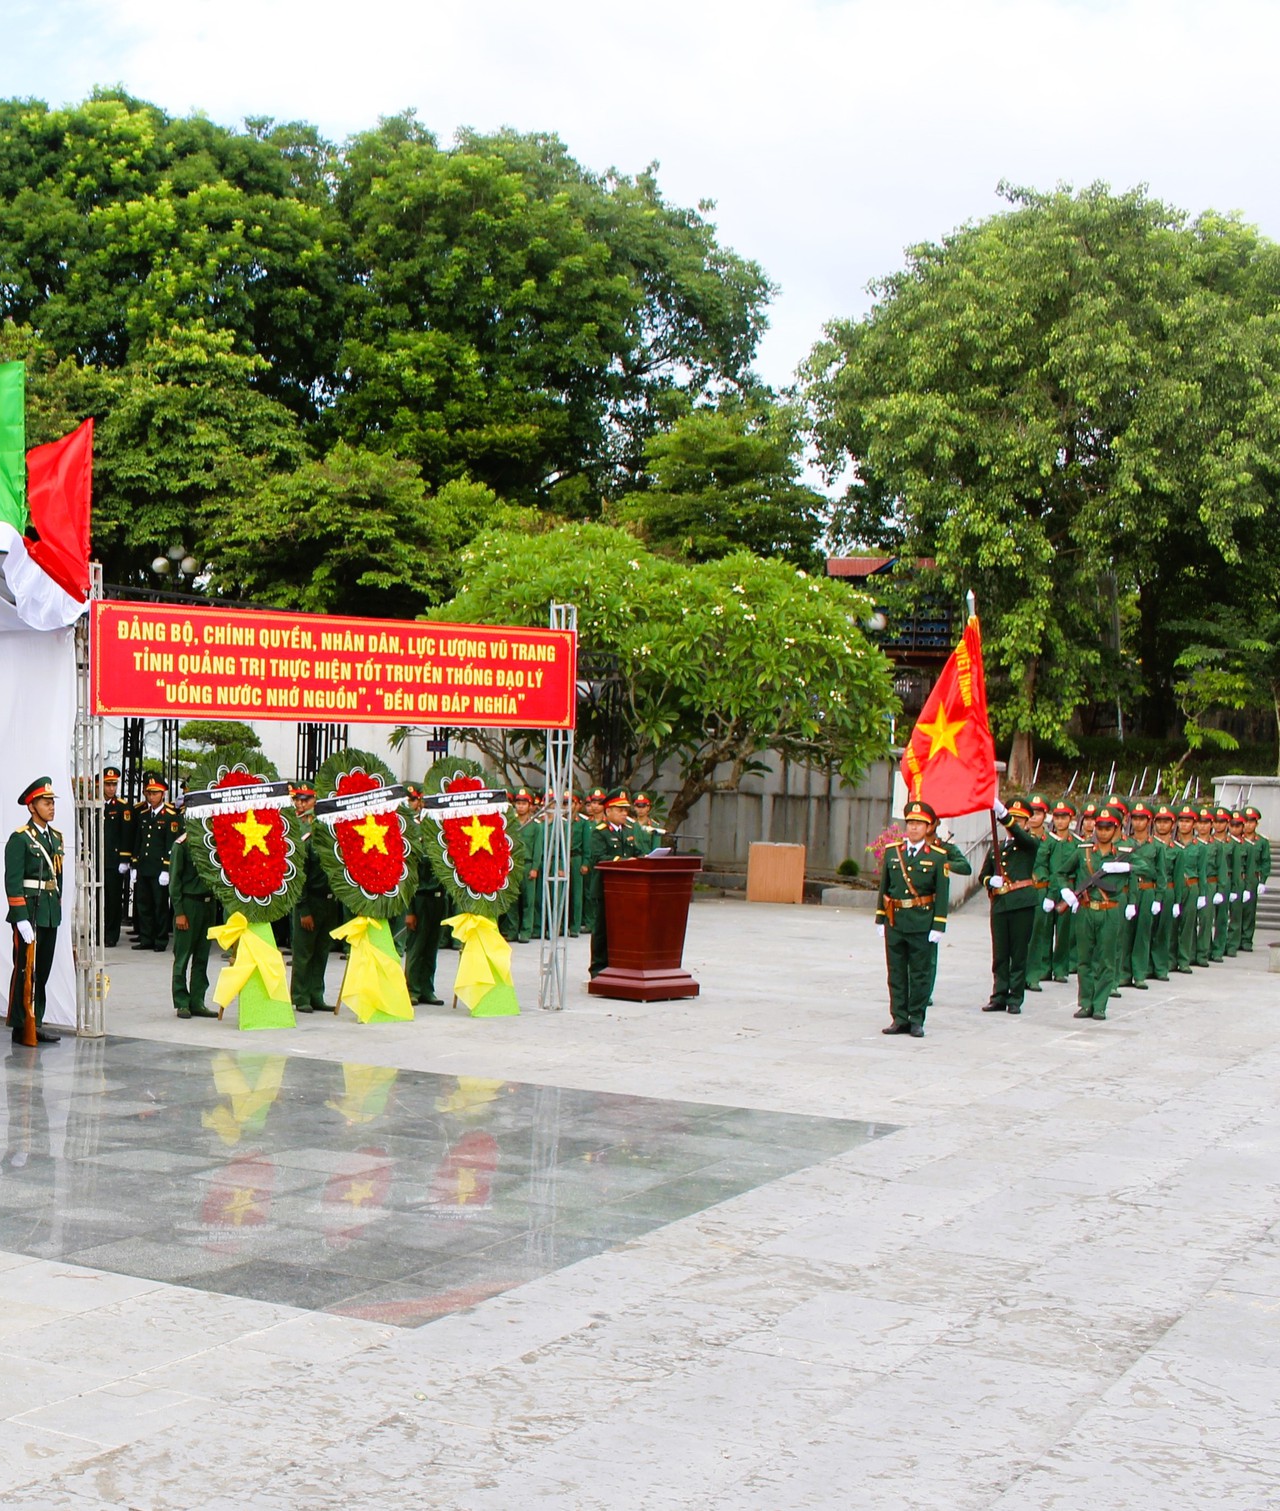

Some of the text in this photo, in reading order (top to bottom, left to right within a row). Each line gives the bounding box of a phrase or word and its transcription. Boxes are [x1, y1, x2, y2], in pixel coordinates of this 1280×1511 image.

[118, 615, 555, 662] ĐẢNG BỘ, CHÍNH QUYỀN, NHÂN DÂN, LỰC LƯỢNG VŨ TRANG
[133, 646, 543, 690] TỈNH QUẢNG TRỊ THỰC HIỆN TỐT TRUYỀN THỐNG ĐẠO LÝ
[217, 684, 262, 706] NƯỚC
[267, 685, 300, 707] NHỚ
[418, 692, 438, 711] ƠN
[441, 692, 470, 712] ĐÁP
